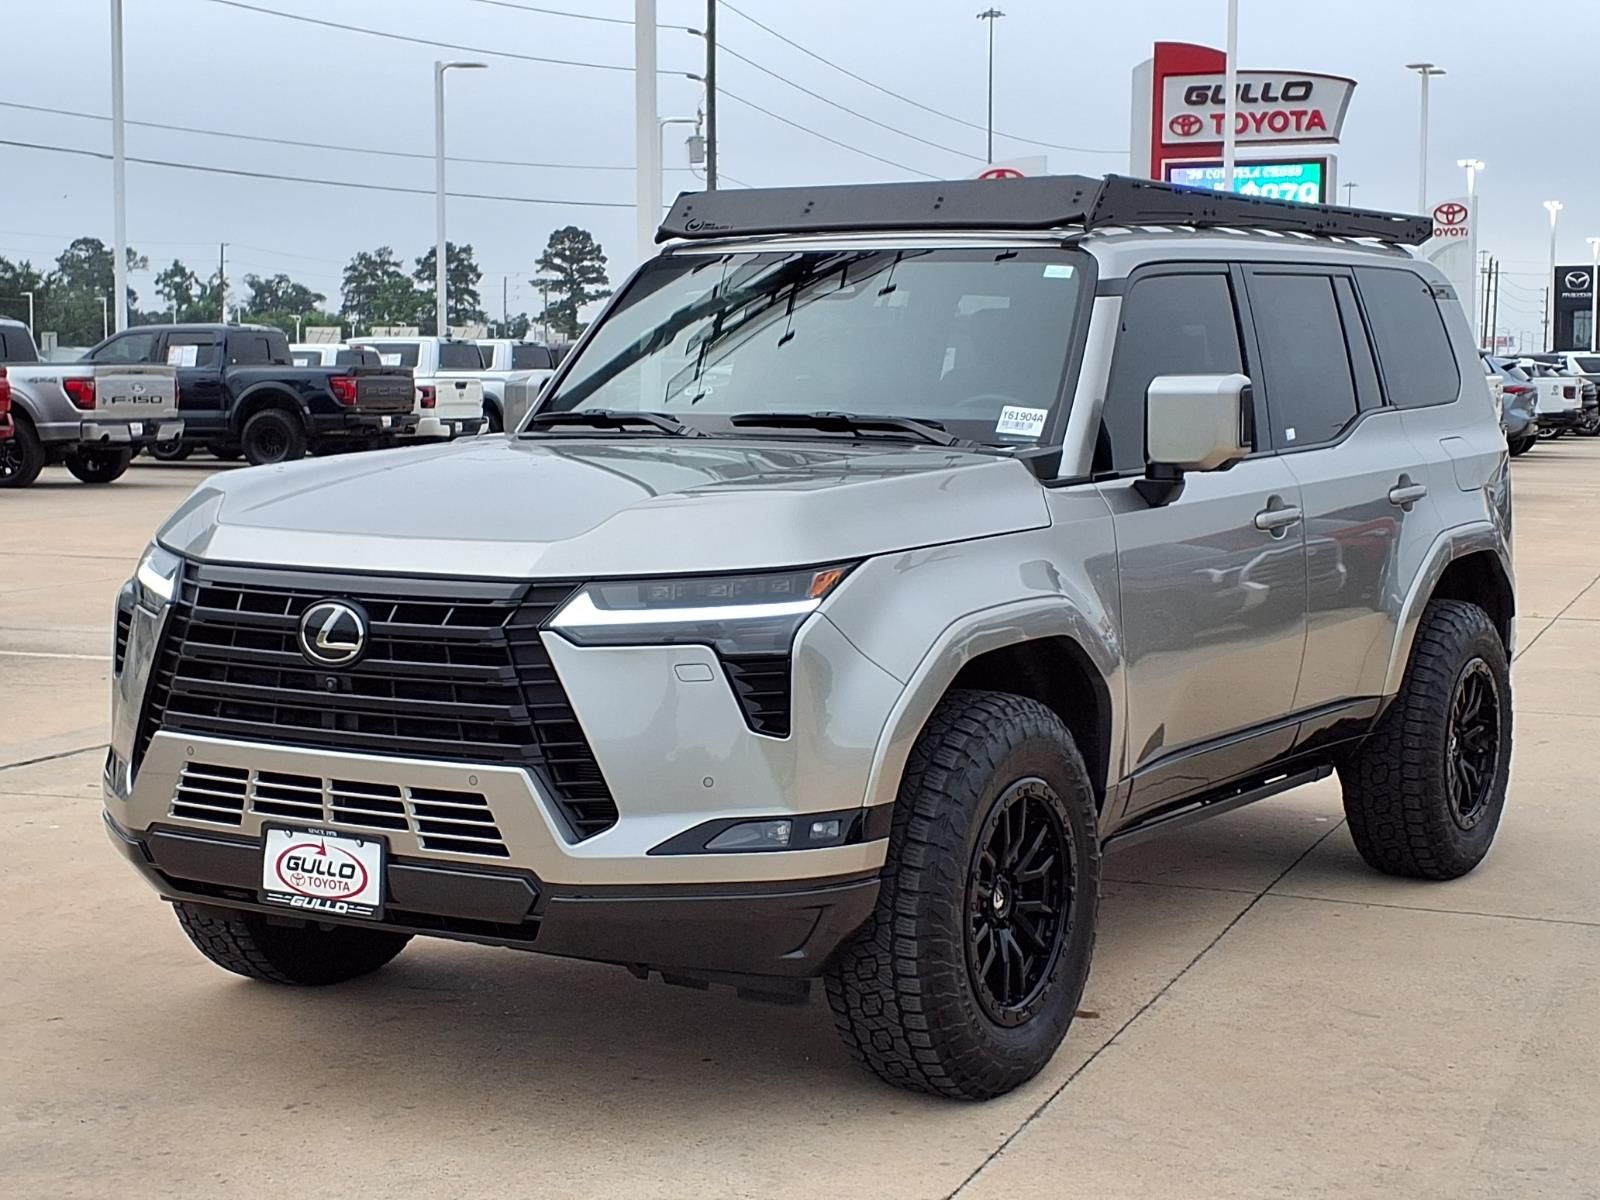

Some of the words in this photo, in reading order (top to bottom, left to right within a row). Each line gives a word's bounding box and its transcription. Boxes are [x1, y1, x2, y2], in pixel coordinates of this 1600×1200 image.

[1184, 81, 1314, 106] GULLO
[1210, 109, 1327, 135] TOYOTA
[1434, 227, 1469, 237] OYOT
[111, 395, 163, 404] F-150
[286, 855, 356, 880] GULLO
[307, 875, 351, 892] TOYOTA
[290, 895, 349, 914] GULLO
